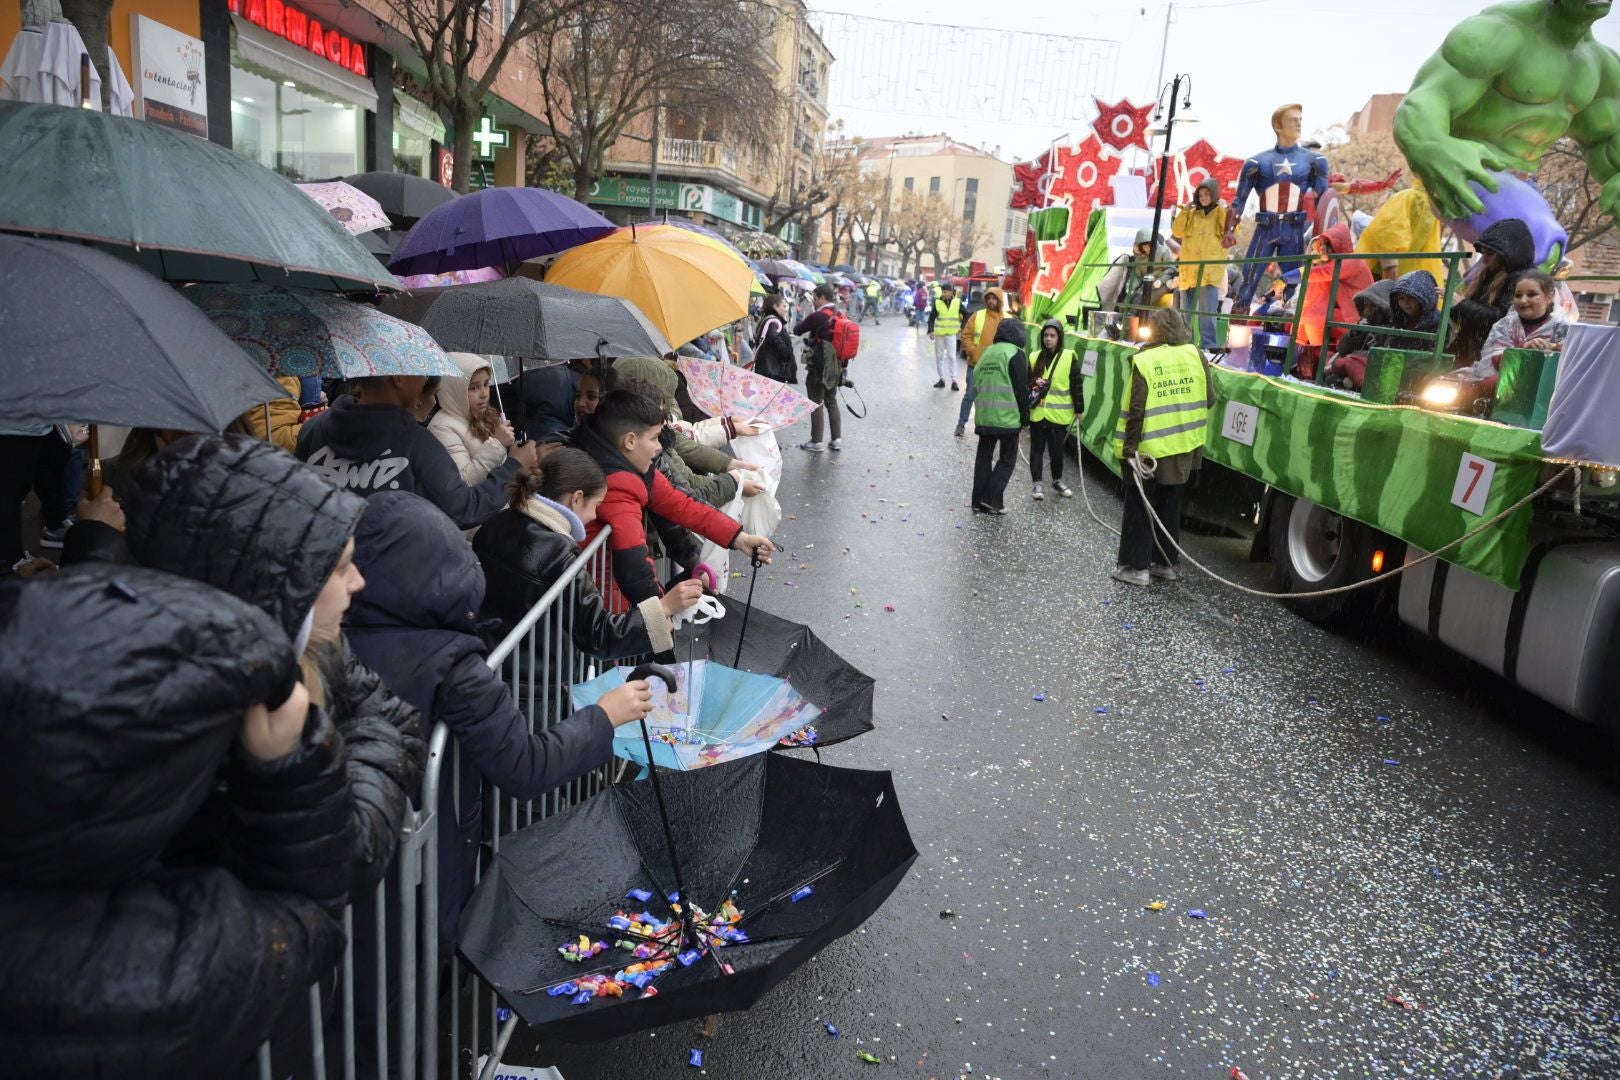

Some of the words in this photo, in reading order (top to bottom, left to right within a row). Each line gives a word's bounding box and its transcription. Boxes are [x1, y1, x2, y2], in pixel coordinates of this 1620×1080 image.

[618, 181, 667, 196] Proyecos
[1157, 389, 1168, 398] DE
[1461, 460, 1485, 504] 7
